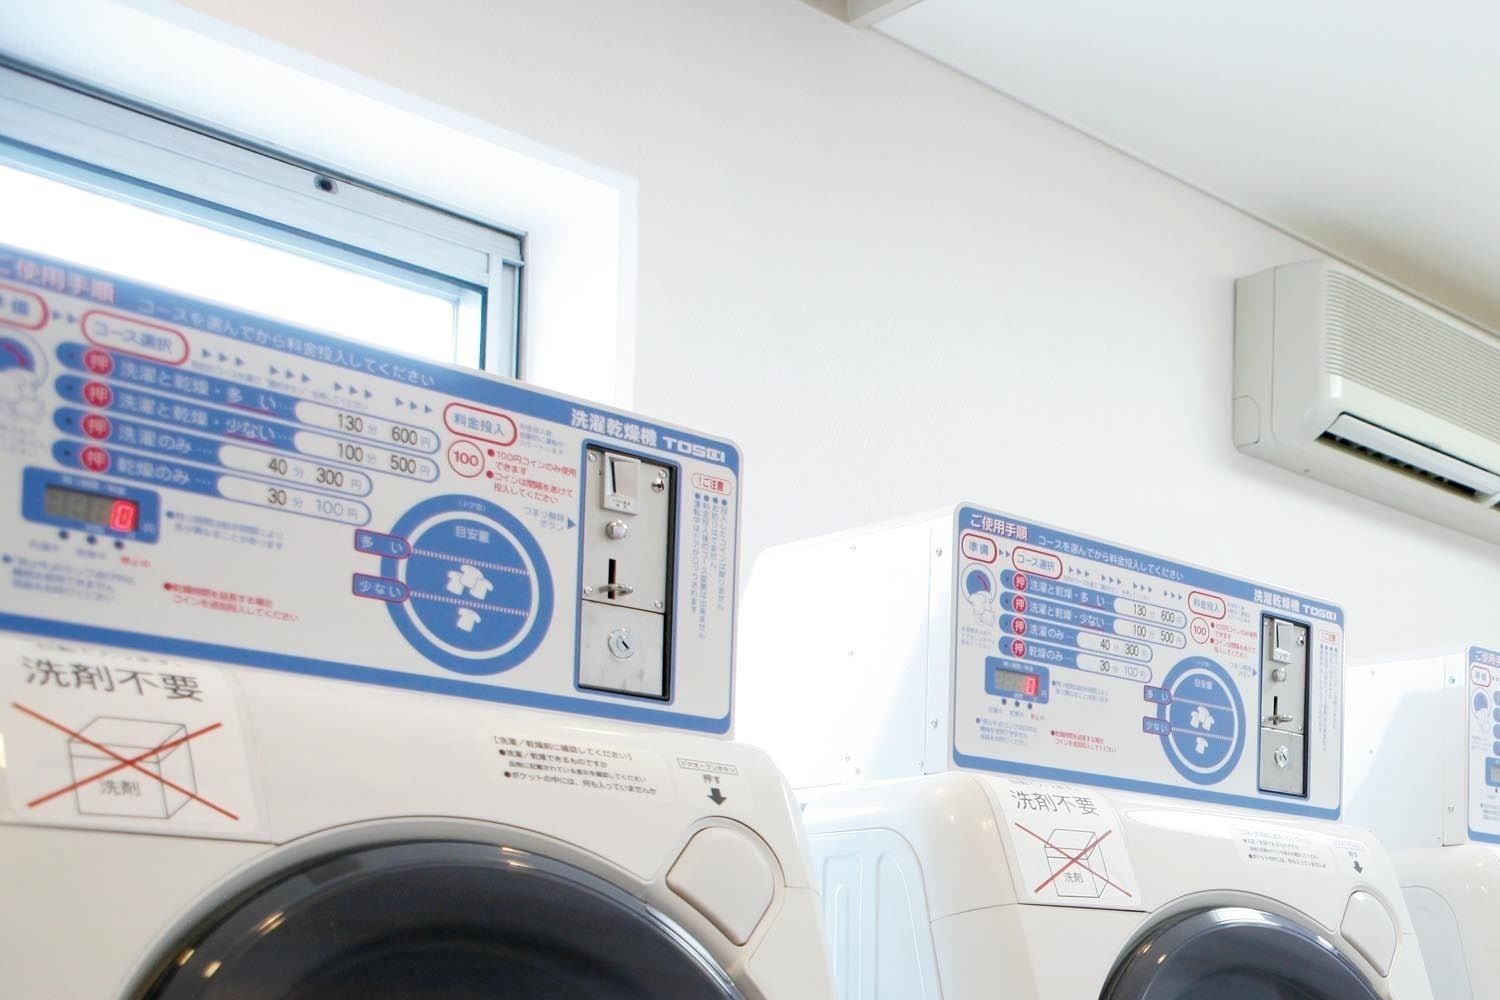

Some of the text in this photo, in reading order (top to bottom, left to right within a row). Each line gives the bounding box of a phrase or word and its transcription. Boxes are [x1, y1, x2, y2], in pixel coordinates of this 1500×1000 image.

[338, 413, 364, 433] 130
[391, 426, 418, 445] 600
[453, 412, 505, 436] 料金投入
[570, 408, 657, 447] 洗濯乾燥機
[337, 442, 364, 462] 100
[390, 455, 417, 474] 500
[453, 451, 479, 467] 100
[268, 458, 288, 476] 40
[316, 467, 344, 487] 300
[267, 488, 287, 506] 30
[316, 499, 344, 516] 100
[970, 513, 1029, 542] ご使用手順
[1133, 603, 1175, 623] 130 600
[1133, 624, 1174, 644] 100 500
[1193, 625, 1207, 636] 100
[1100, 639, 1139, 656] 40 300
[1100, 660, 1110, 672] 30
[21, 656, 204, 703] 洗剤不要
[101, 780, 141, 798] 洗剤
[1009, 789, 1100, 816] 洗剤不要
